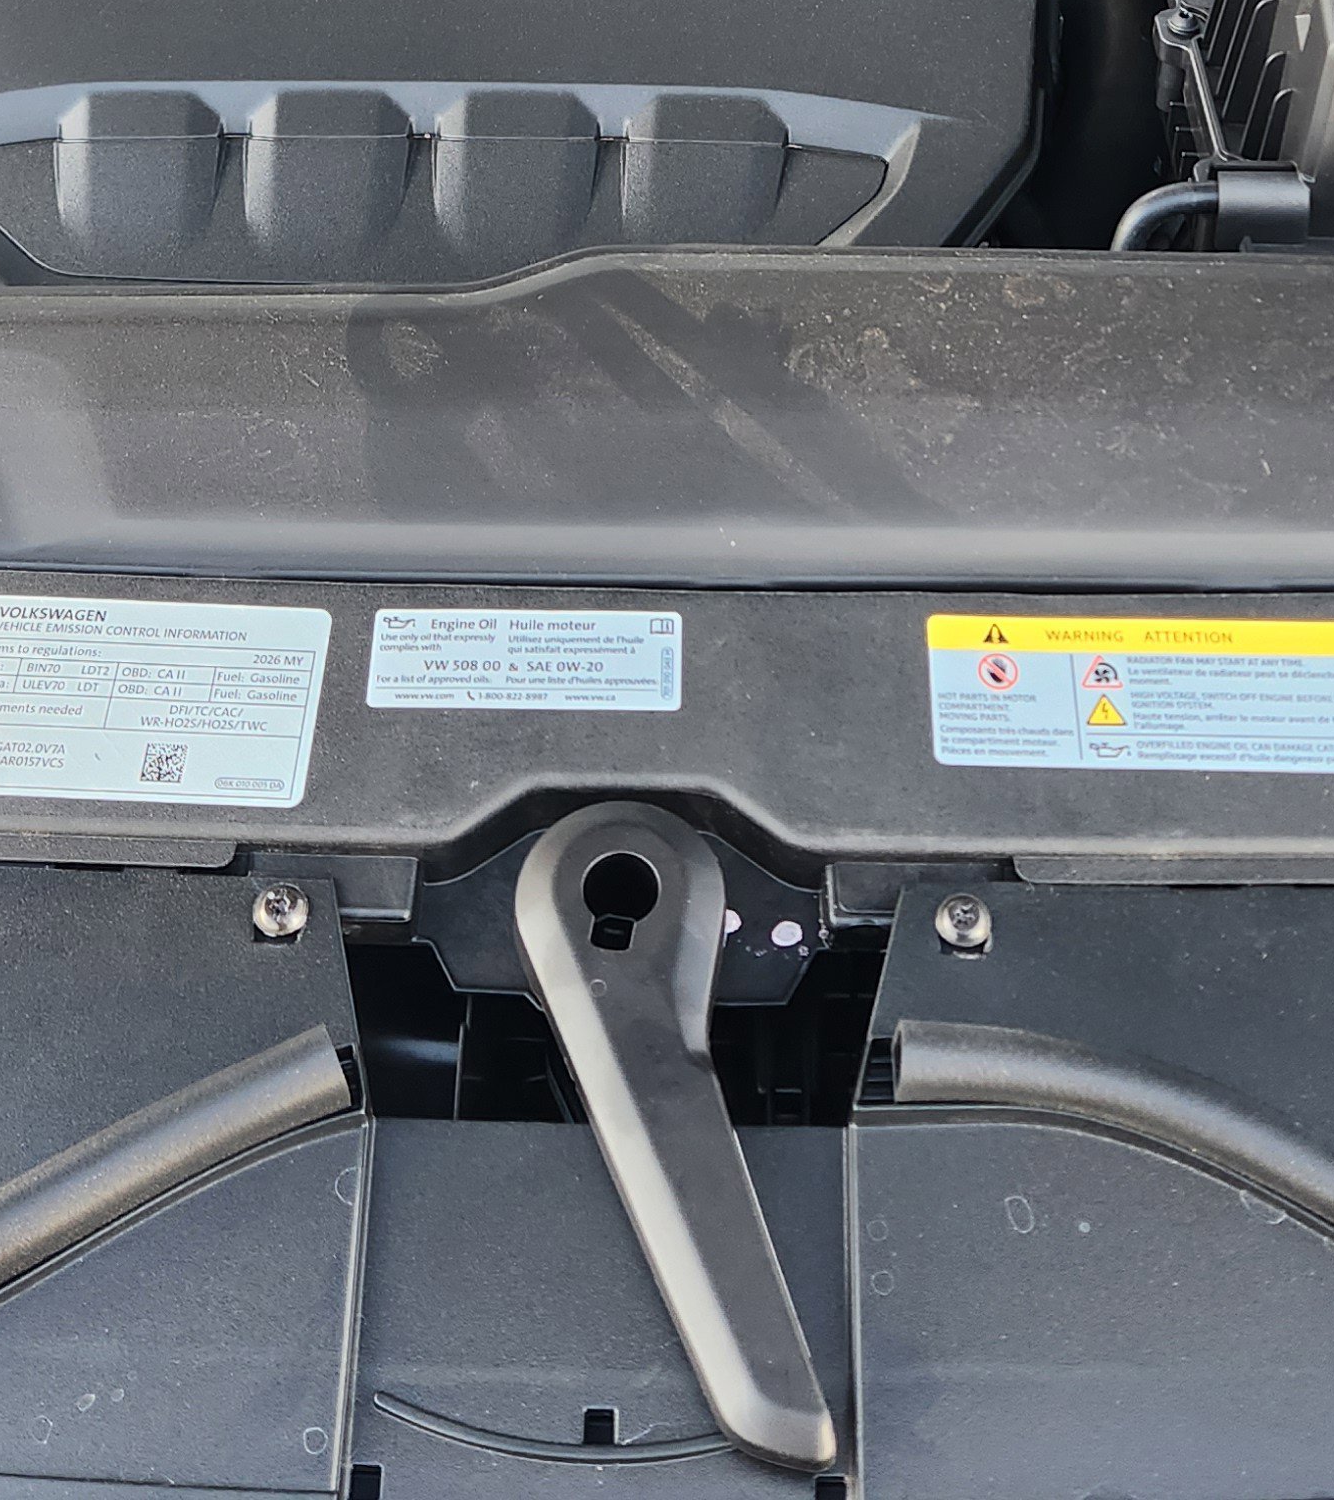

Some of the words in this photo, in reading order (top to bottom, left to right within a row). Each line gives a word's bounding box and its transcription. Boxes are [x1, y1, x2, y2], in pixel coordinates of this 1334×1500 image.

[0, 605, 107, 622] VOLKSWAGEN
[44, 622, 103, 635] EMISSION
[104, 624, 160, 638] CONTROL
[162, 627, 248, 642] INFORMATION
[1044, 629, 1124, 642] WARNING
[1143, 629, 1233, 643] ATTENTION
[16, 643, 30, 655] to
[30, 643, 102, 658] regulations:
[251, 653, 282, 665] 2026
[282, 654, 304, 666] MY
[25, 661, 62, 674] BIN70
[79, 664, 110, 676] LDT2
[120, 665, 152, 678] OBD:
[156, 667, 174, 680] CA
[215, 670, 245, 683] Fuel:
[248, 671, 301, 685] Gasoline
[21, 678, 66, 691] ULEV70
[76, 680, 100, 693] LDT
[116, 682, 147, 695] OBD:
[152, 684, 170, 697] CA
[212, 686, 241, 700] Fuel:
[245, 688, 298, 702] Gasoline
[37, 703, 84, 716] needed
[168, 703, 244, 718] DFI/TC/CAC/
[139, 714, 268, 732] WR-HO2S/HO2S/TWC
